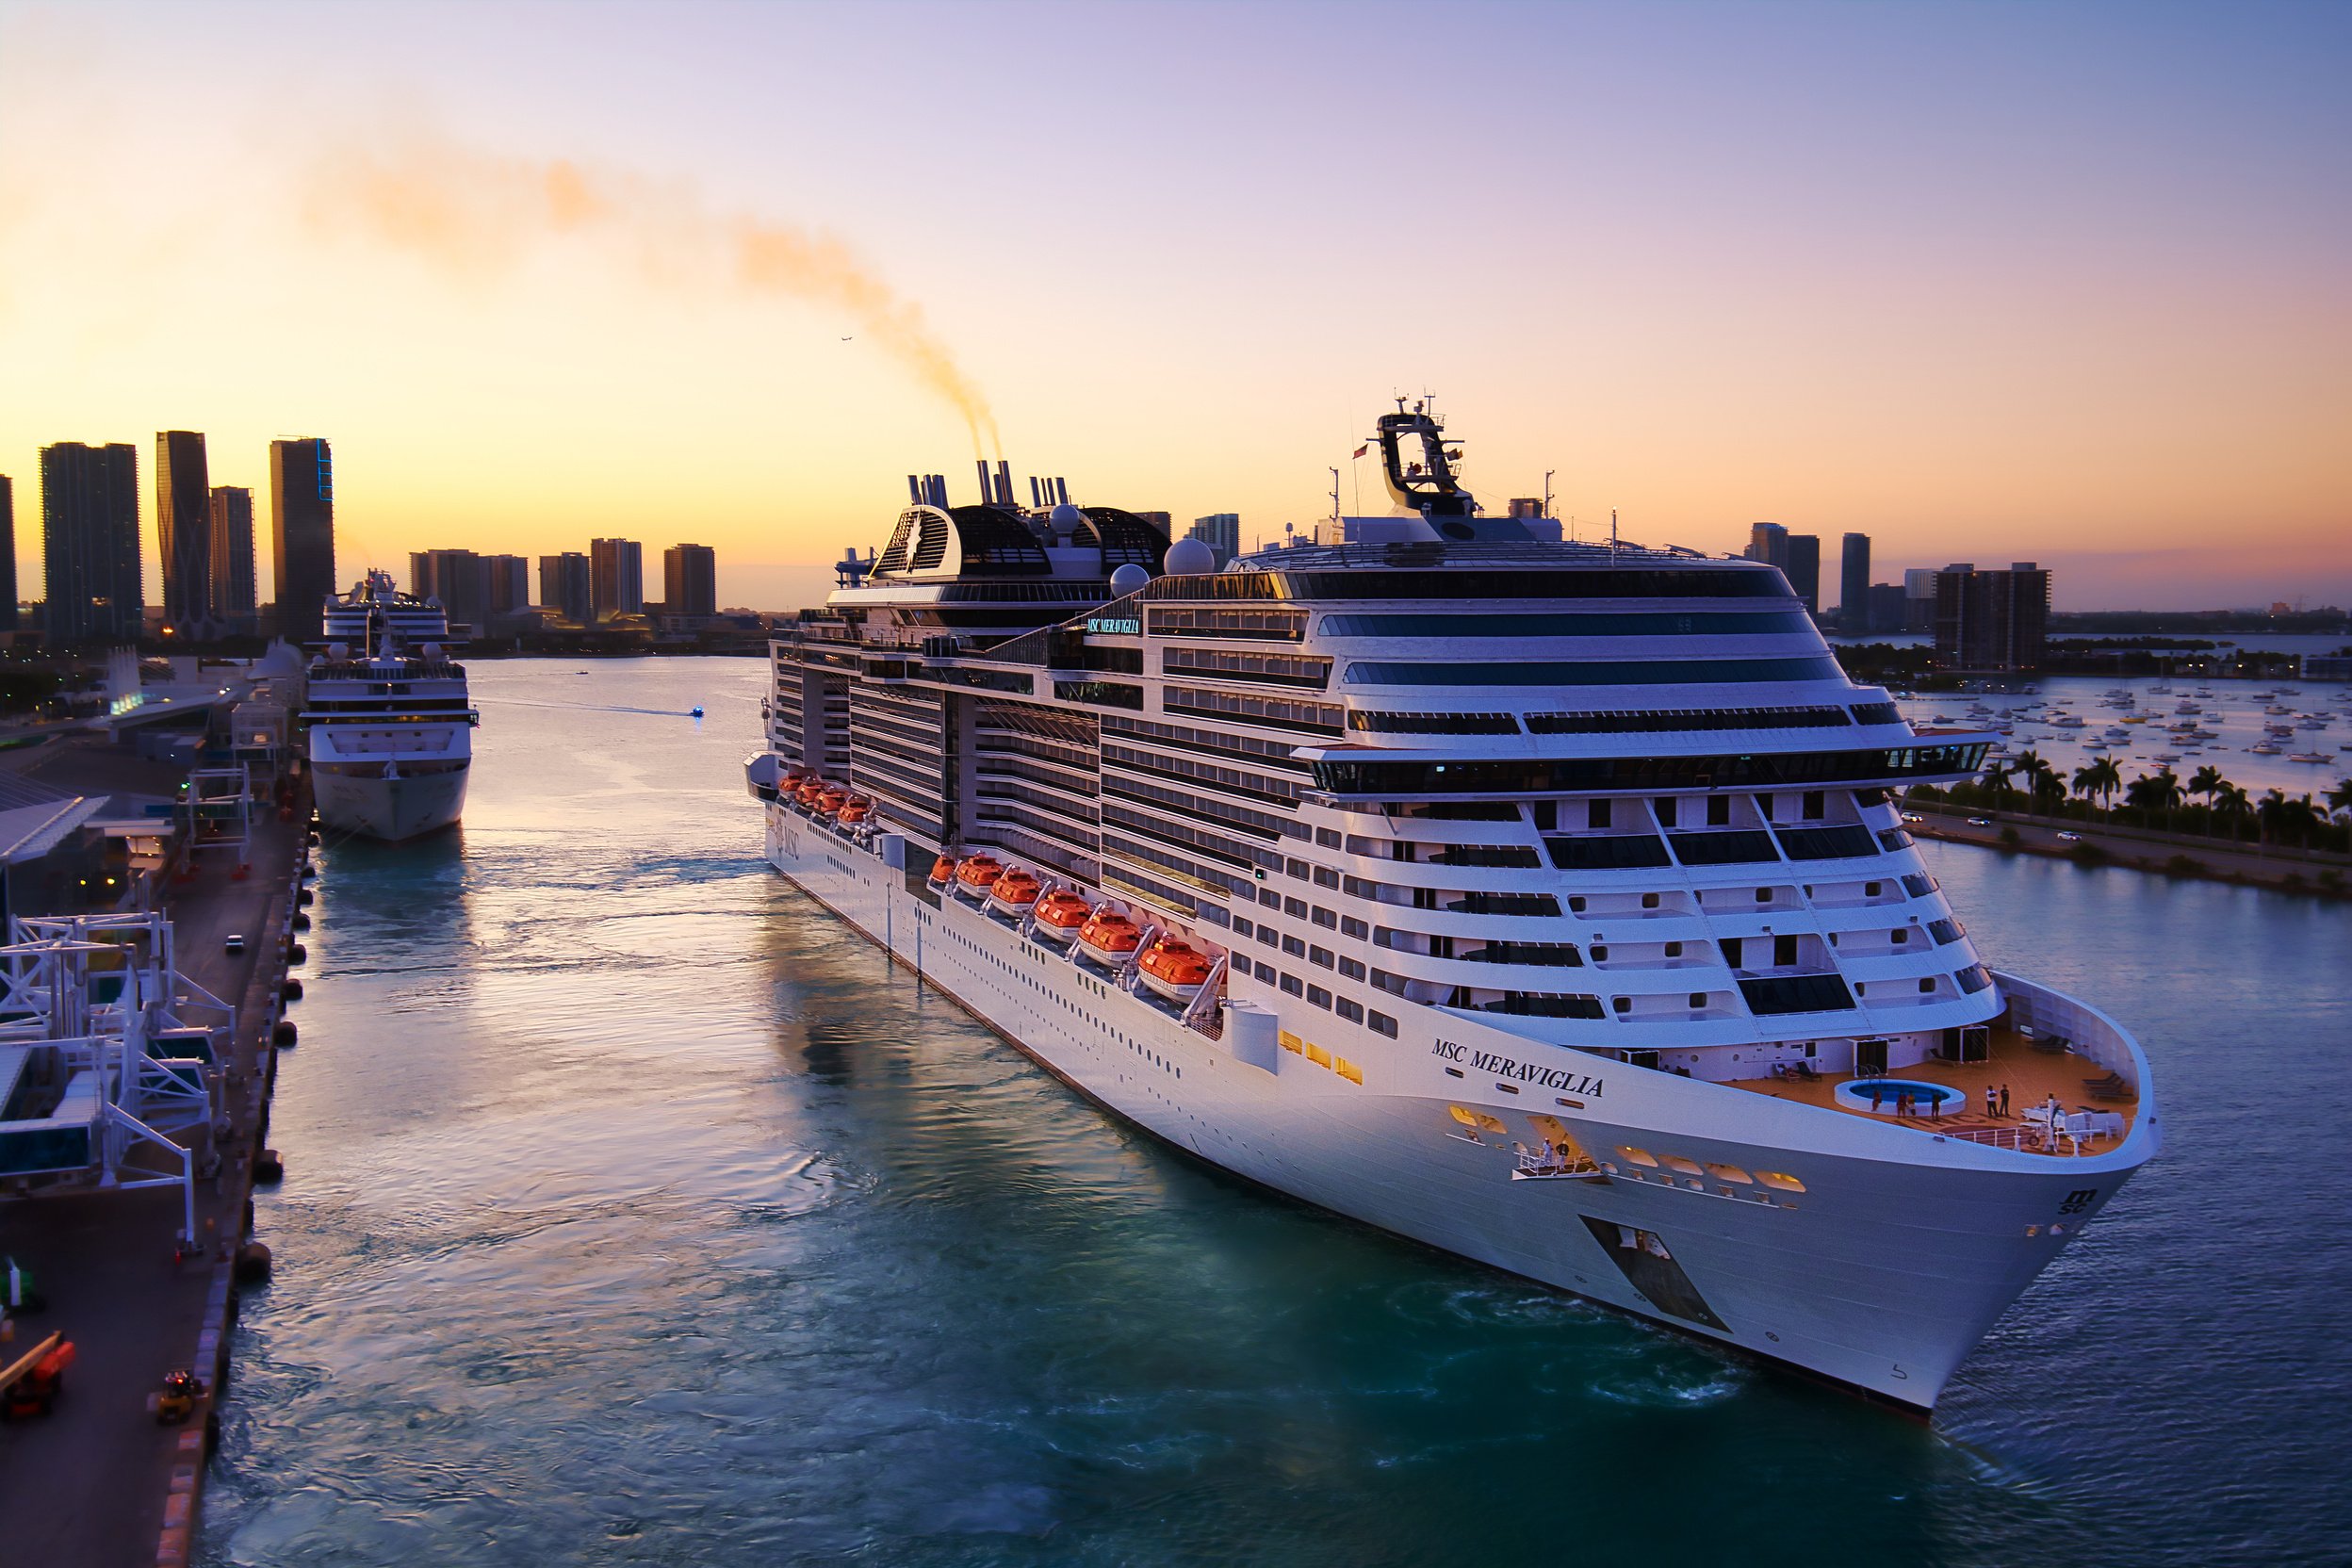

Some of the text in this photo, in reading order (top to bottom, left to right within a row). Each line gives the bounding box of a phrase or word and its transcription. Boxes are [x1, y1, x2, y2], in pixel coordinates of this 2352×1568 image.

[1087, 618, 1138, 634] MSC MERAVIGLIA
[1431, 1038, 1604, 1098] MSC MERAVIGLIA
